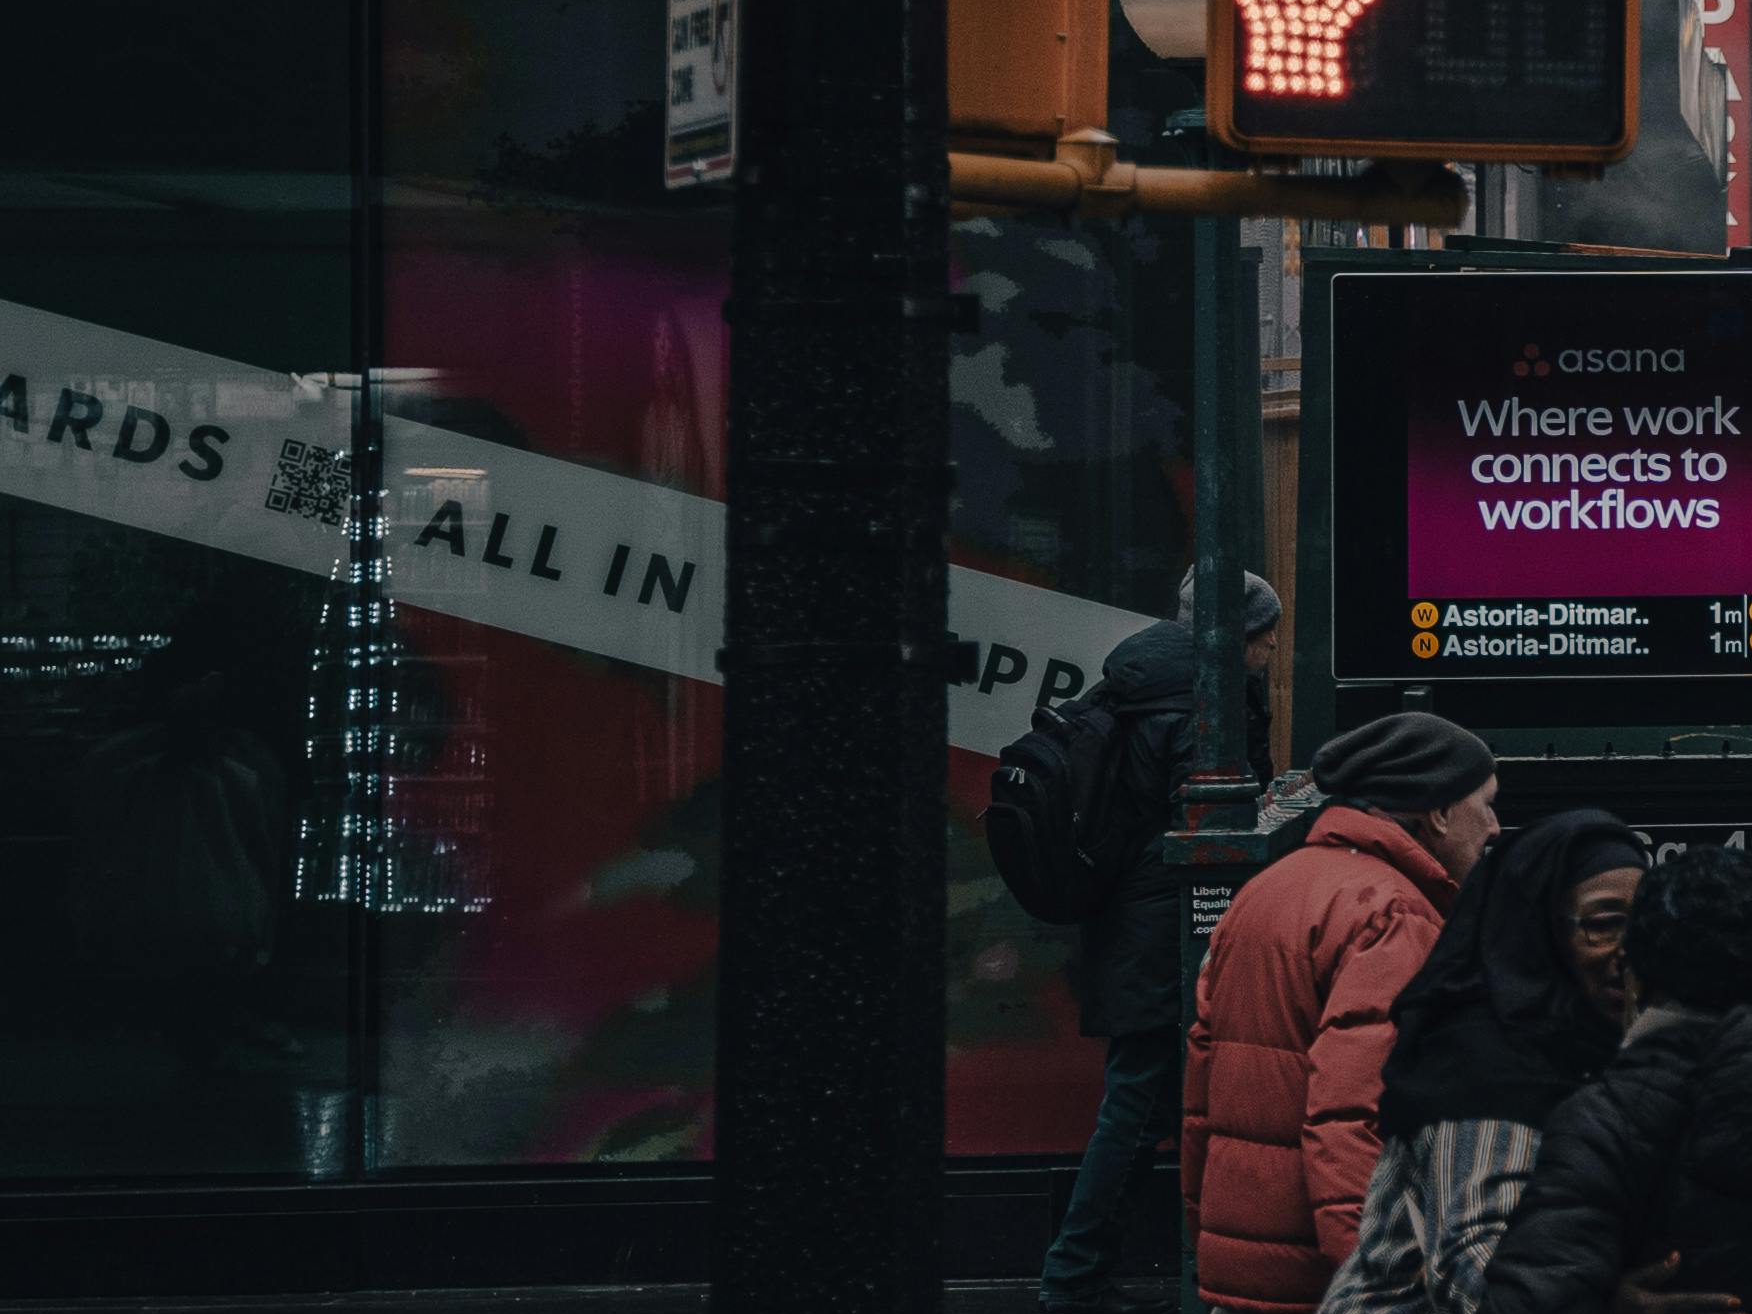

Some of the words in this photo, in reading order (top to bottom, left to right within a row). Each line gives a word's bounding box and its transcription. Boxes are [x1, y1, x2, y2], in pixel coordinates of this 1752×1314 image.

[1558, 348, 1685, 373] asana
[1457, 396, 1613, 437] Where
[1622, 394, 1741, 436] work
[1470, 448, 1672, 483] connects
[1680, 447, 1728, 482] to
[1478, 488, 1720, 530] workflows
[414, 499, 563, 582] ALL
[603, 544, 697, 614] IN
[1417, 608, 1434, 623] W
[1442, 603, 1649, 627] Astoria-Ditmar..
[1419, 638, 1432, 652] N
[1442, 633, 1649, 657] Astoria-Ditmar..
[1193, 886, 1232, 896] Liberty
[1193, 899, 1232, 910] Equalit
